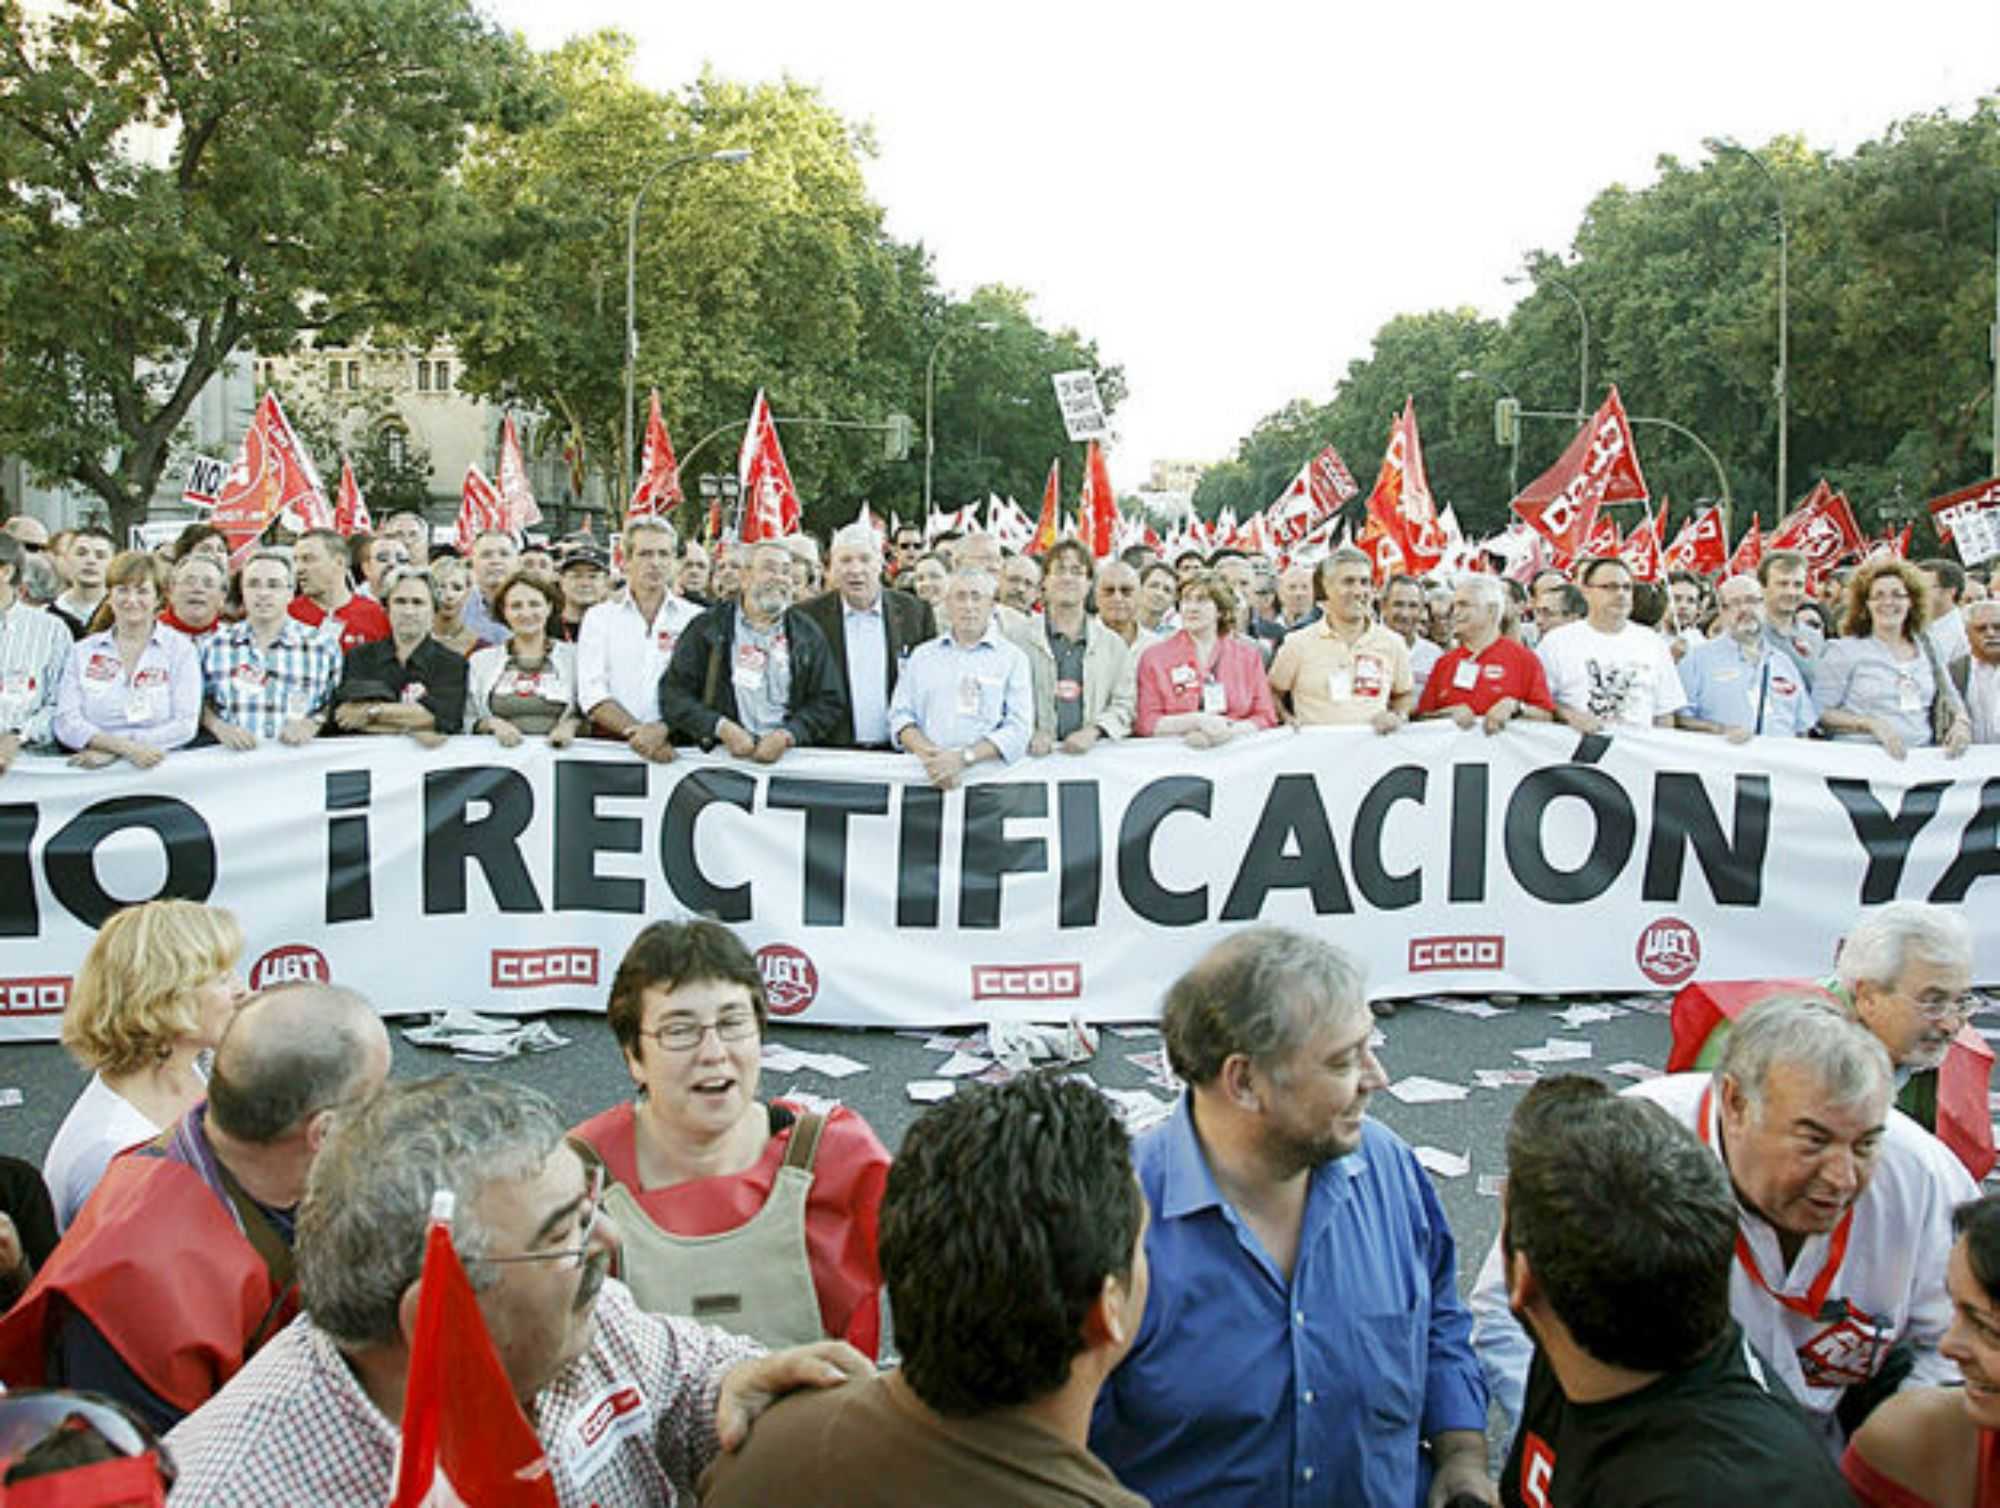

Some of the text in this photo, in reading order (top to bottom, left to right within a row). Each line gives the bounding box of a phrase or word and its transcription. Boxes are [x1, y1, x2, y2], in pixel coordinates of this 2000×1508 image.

[423, 735, 1771, 928] RECTIFICACIÓN
[1412, 939, 1499, 967] CCOO
[1645, 928, 1692, 957] UGT
[261, 953, 321, 985] UGT
[497, 953, 595, 982] CCOO
[756, 953, 807, 986] UGT
[977, 968, 1077, 996] CCOO
